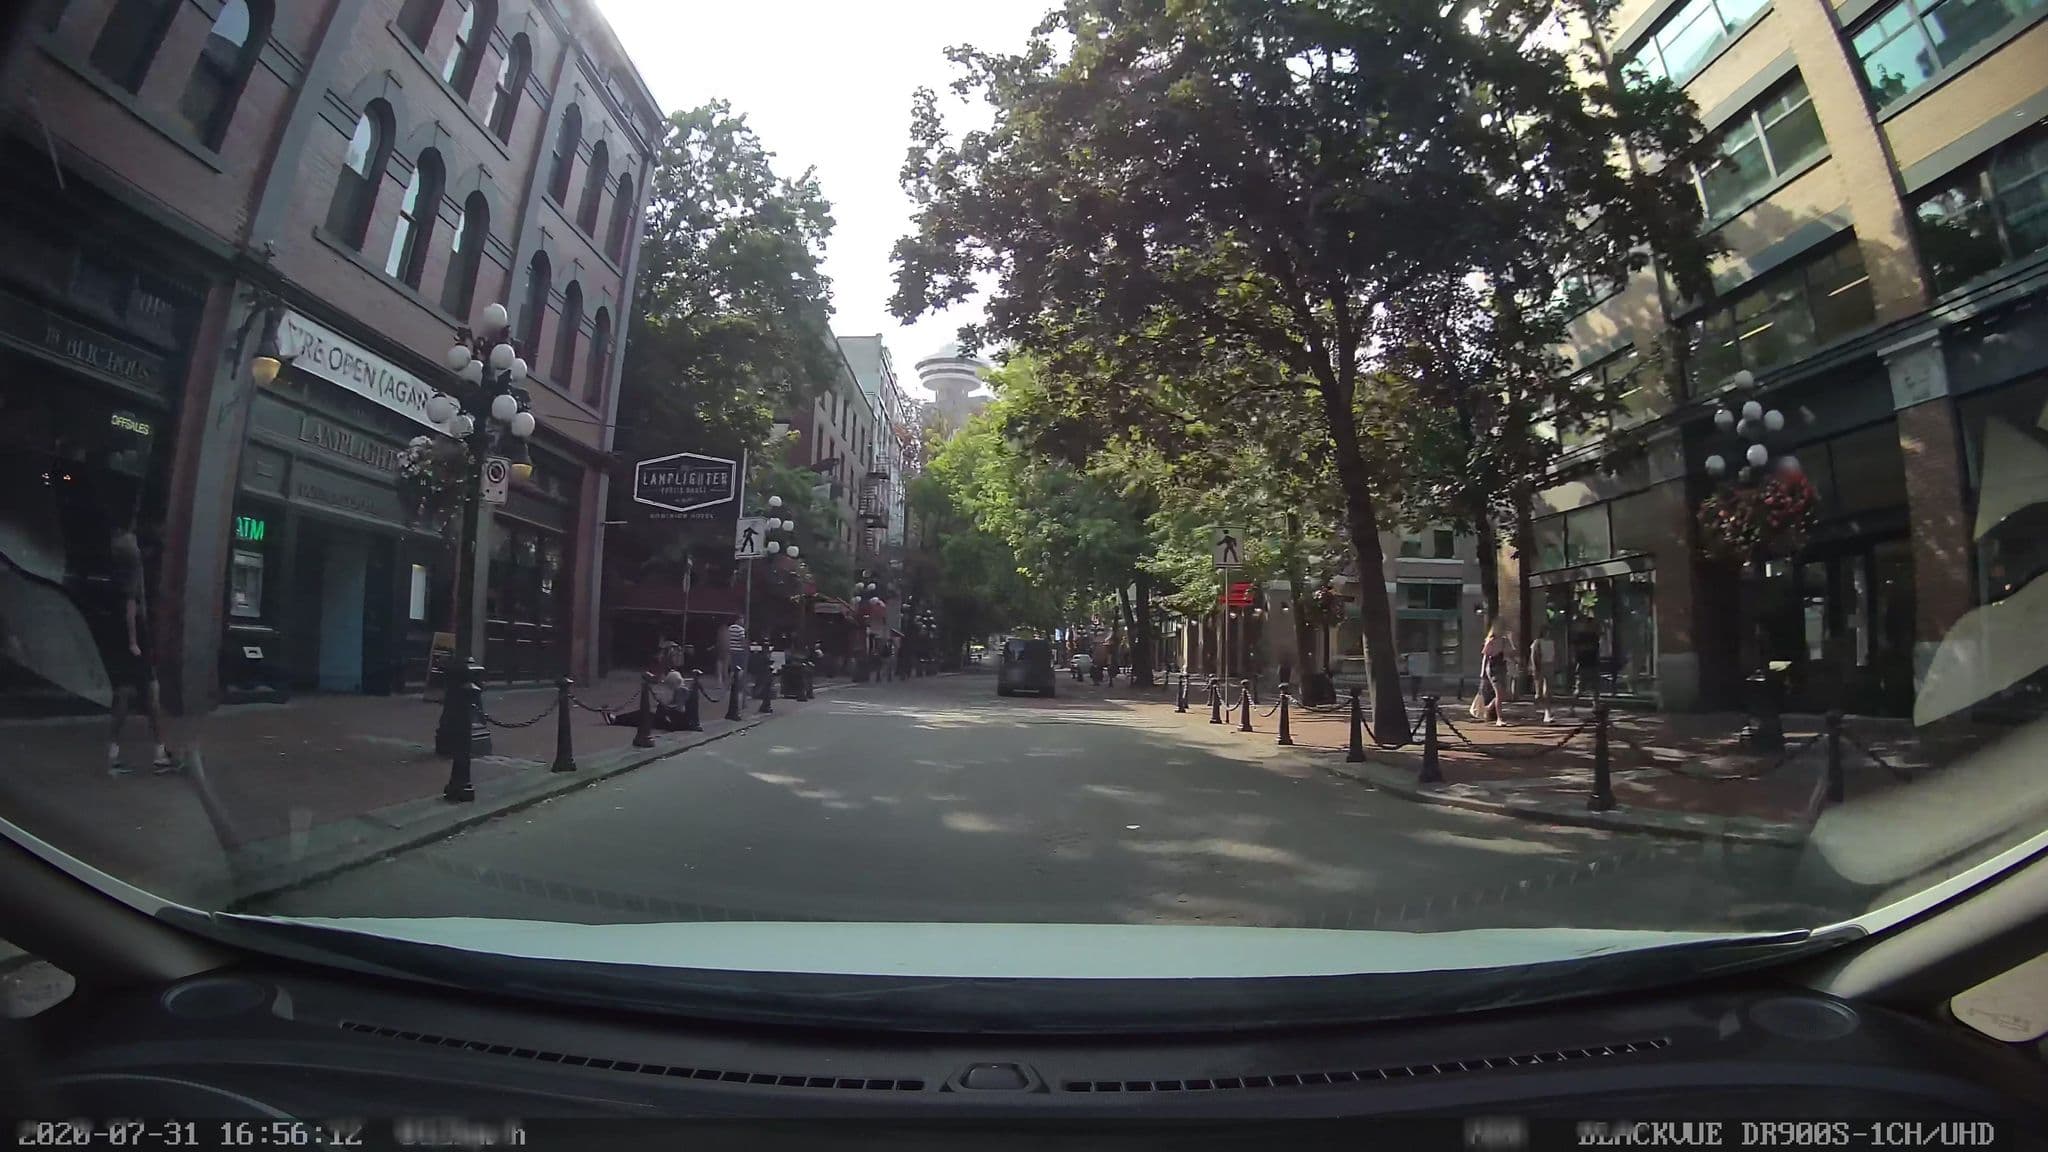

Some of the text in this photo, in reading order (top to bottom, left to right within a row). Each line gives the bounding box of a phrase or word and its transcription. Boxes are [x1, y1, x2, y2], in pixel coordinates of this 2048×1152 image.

[328, 346, 377, 388] OPEN
[643, 472, 728, 486] LAMPLIGHTER
[236, 516, 265, 541] ATM
